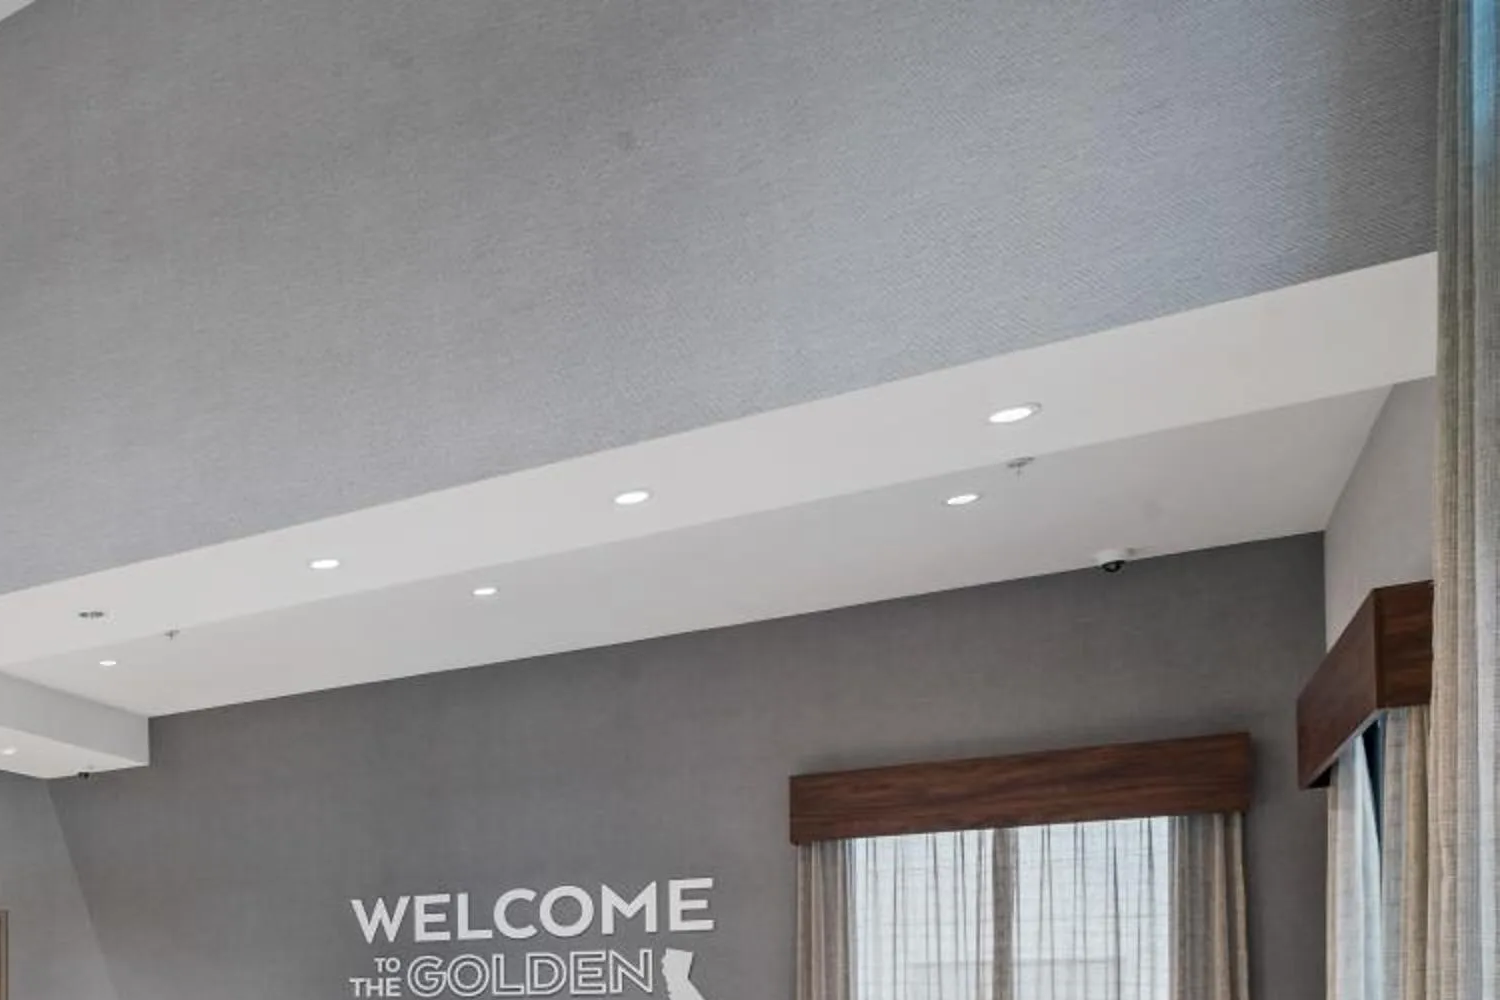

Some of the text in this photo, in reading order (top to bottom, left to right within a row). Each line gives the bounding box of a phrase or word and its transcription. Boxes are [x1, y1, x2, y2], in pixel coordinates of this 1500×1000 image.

[350, 877, 715, 945] WELCOME
[373, 957, 401, 973] TO
[407, 948, 654, 997] GOLDEN
[349, 977, 402, 998] THE
